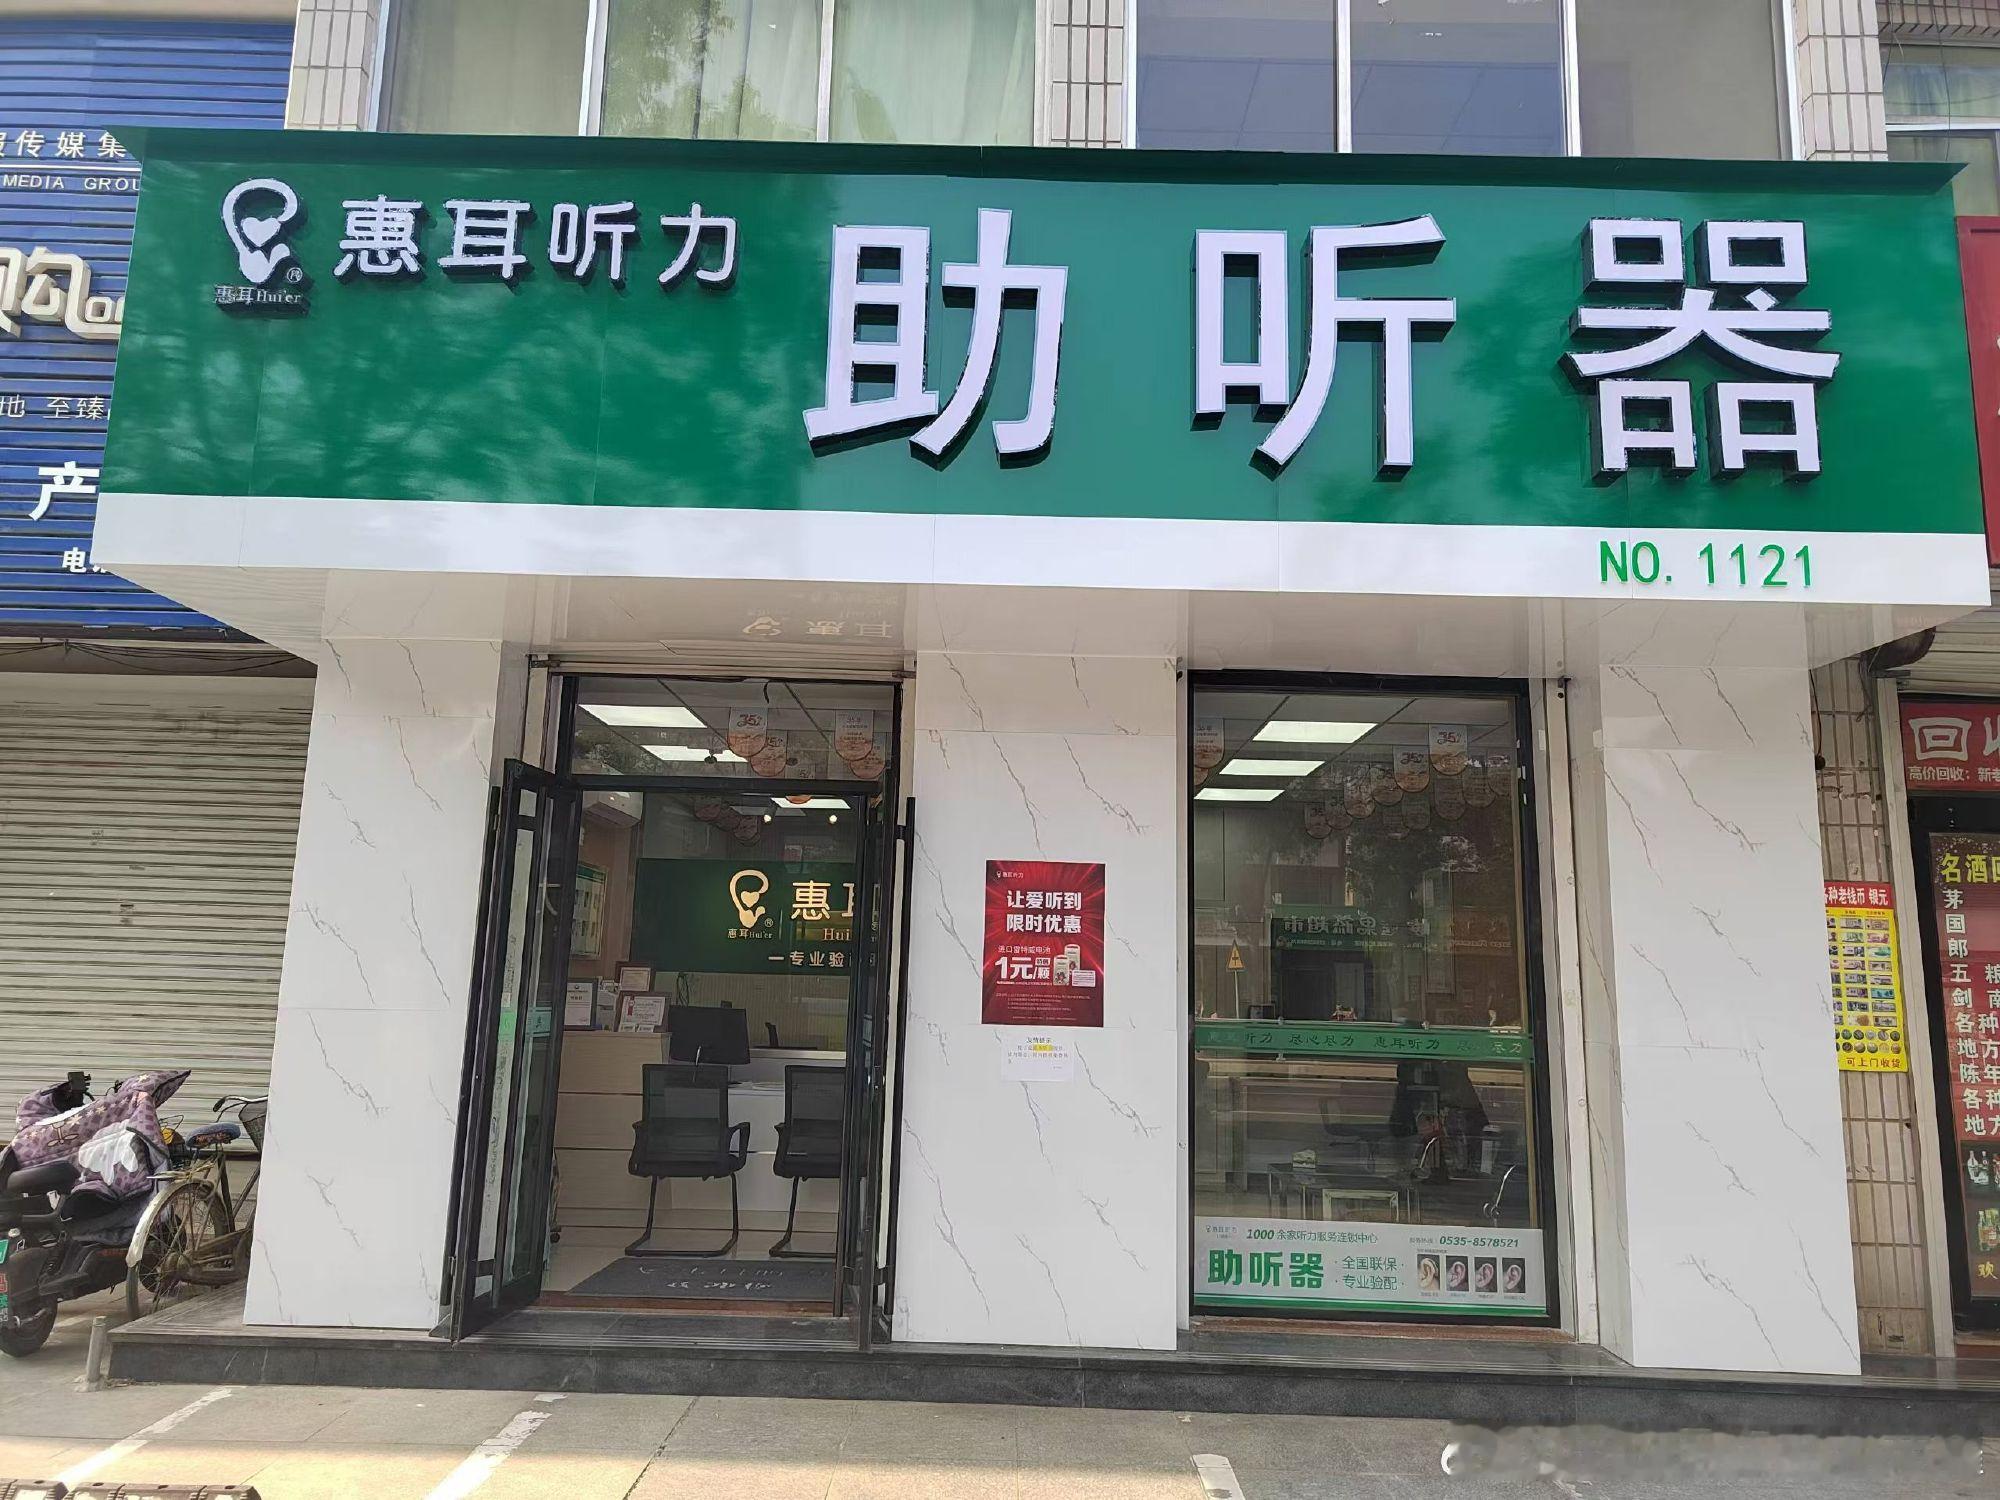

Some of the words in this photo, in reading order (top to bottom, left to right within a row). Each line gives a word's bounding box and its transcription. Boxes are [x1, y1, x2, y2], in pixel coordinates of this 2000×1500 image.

[3, 174, 65, 190] MEDIA
[333, 193, 742, 287] 惠耳听力
[802, 207, 1842, 475] 助听器
[42, 396, 111, 421] 至臻
[28, 460, 101, 521] 产
[62, 547, 107, 574] 电
[1600, 540, 1673, 584] NO.
[1697, 542, 1812, 588] 1121
[1908, 714, 2000, 761] 回
[1007, 890, 1082, 910] 让爱听到
[1943, 889, 1963, 909] 茅
[1007, 914, 1082, 934] 限时优惠
[1946, 914, 1966, 934] 国
[1948, 938, 1968, 959] 郎
[1955, 1012, 1999, 1034] 各种
[1846, 1056, 1901, 1069] 可上门收货
[1246, 1229, 1275, 1240] 1000
[1276, 1230, 1378, 1244] 余家听力服务连锁中心
[1439, 1235, 1519, 1248] 0535-8578521
[1207, 1249, 1324, 1289] 助听器
[1342, 1255, 1398, 1272] 全国联保
[1342, 1274, 1398, 1291] 专业验配
